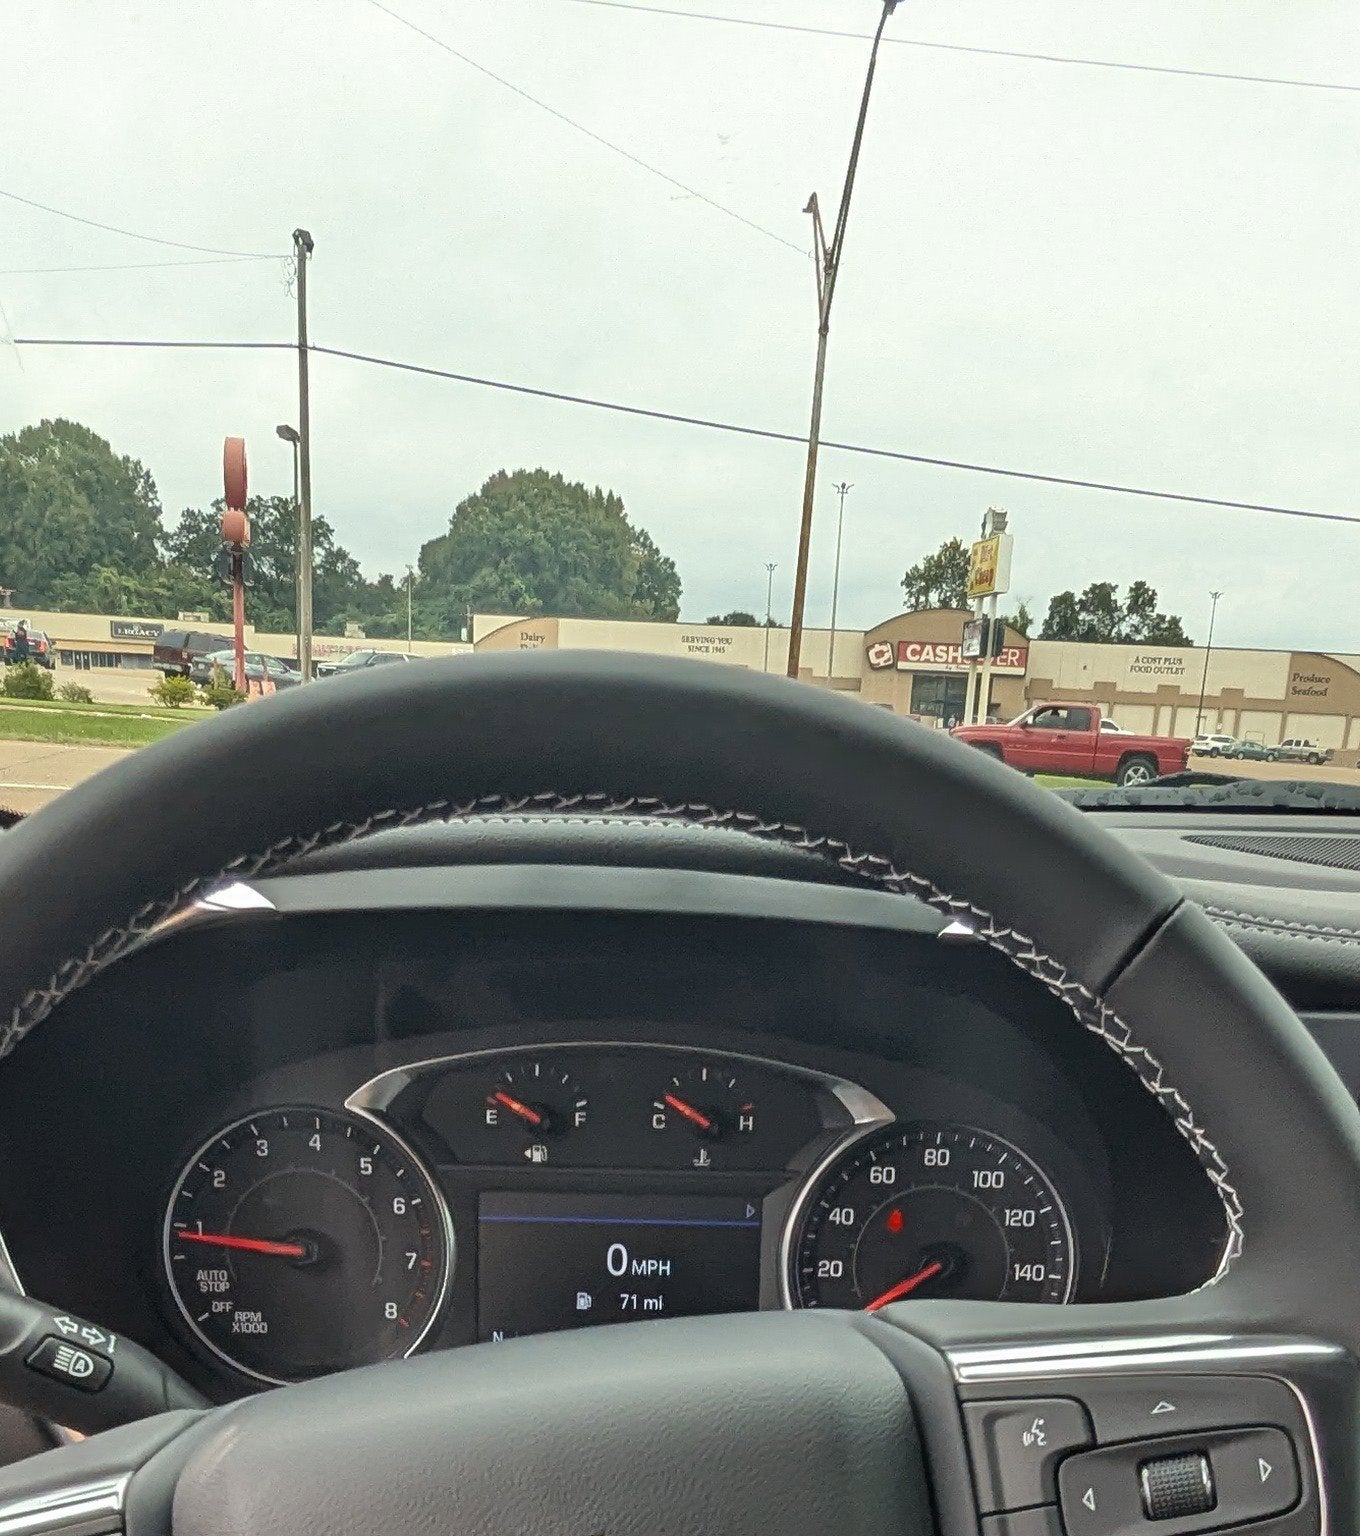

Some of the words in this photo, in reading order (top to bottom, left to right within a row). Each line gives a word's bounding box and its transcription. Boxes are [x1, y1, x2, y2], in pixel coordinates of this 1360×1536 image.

[520, 632, 546, 644] Dairy
[1141, 657, 1162, 665] COST
[1163, 657, 1183, 665] PLUS
[1130, 665, 1152, 674] FOOD
[1153, 666, 1186, 675] OUTLET
[1292, 673, 1331, 684] Produce
[1291, 687, 1328, 697] Seafood
[486, 1110, 498, 1125] E
[575, 1112, 586, 1127] F
[652, 1114, 666, 1129] C
[739, 1116, 753, 1132] H
[256, 1139, 269, 1156] 3
[308, 1134, 321, 1152] 4
[924, 1149, 950, 1167] 80
[360, 1158, 372, 1175] 5
[214, 1170, 226, 1188] 2
[869, 1166, 896, 1184] 60
[972, 1170, 1004, 1189] 100
[393, 1198, 405, 1215] 6
[828, 1208, 854, 1226] 40
[1004, 1209, 1035, 1228] 120
[405, 1252, 417, 1269] 7
[606, 1243, 628, 1277] 0
[631, 1259, 671, 1276] MPH
[197, 1270, 228, 1281] AUTO
[817, 1260, 843, 1278] 20
[1013, 1263, 1045, 1282] 140
[200, 1281, 230, 1293] STOP
[211, 1301, 234, 1313] OFF
[620, 1294, 637, 1310] 71
[644, 1295, 663, 1310] mi
[234, 1311, 261, 1322] RPM
[385, 1302, 398, 1320] 8
[232, 1322, 268, 1334] X1000
[492, 1331, 504, 1343] N
